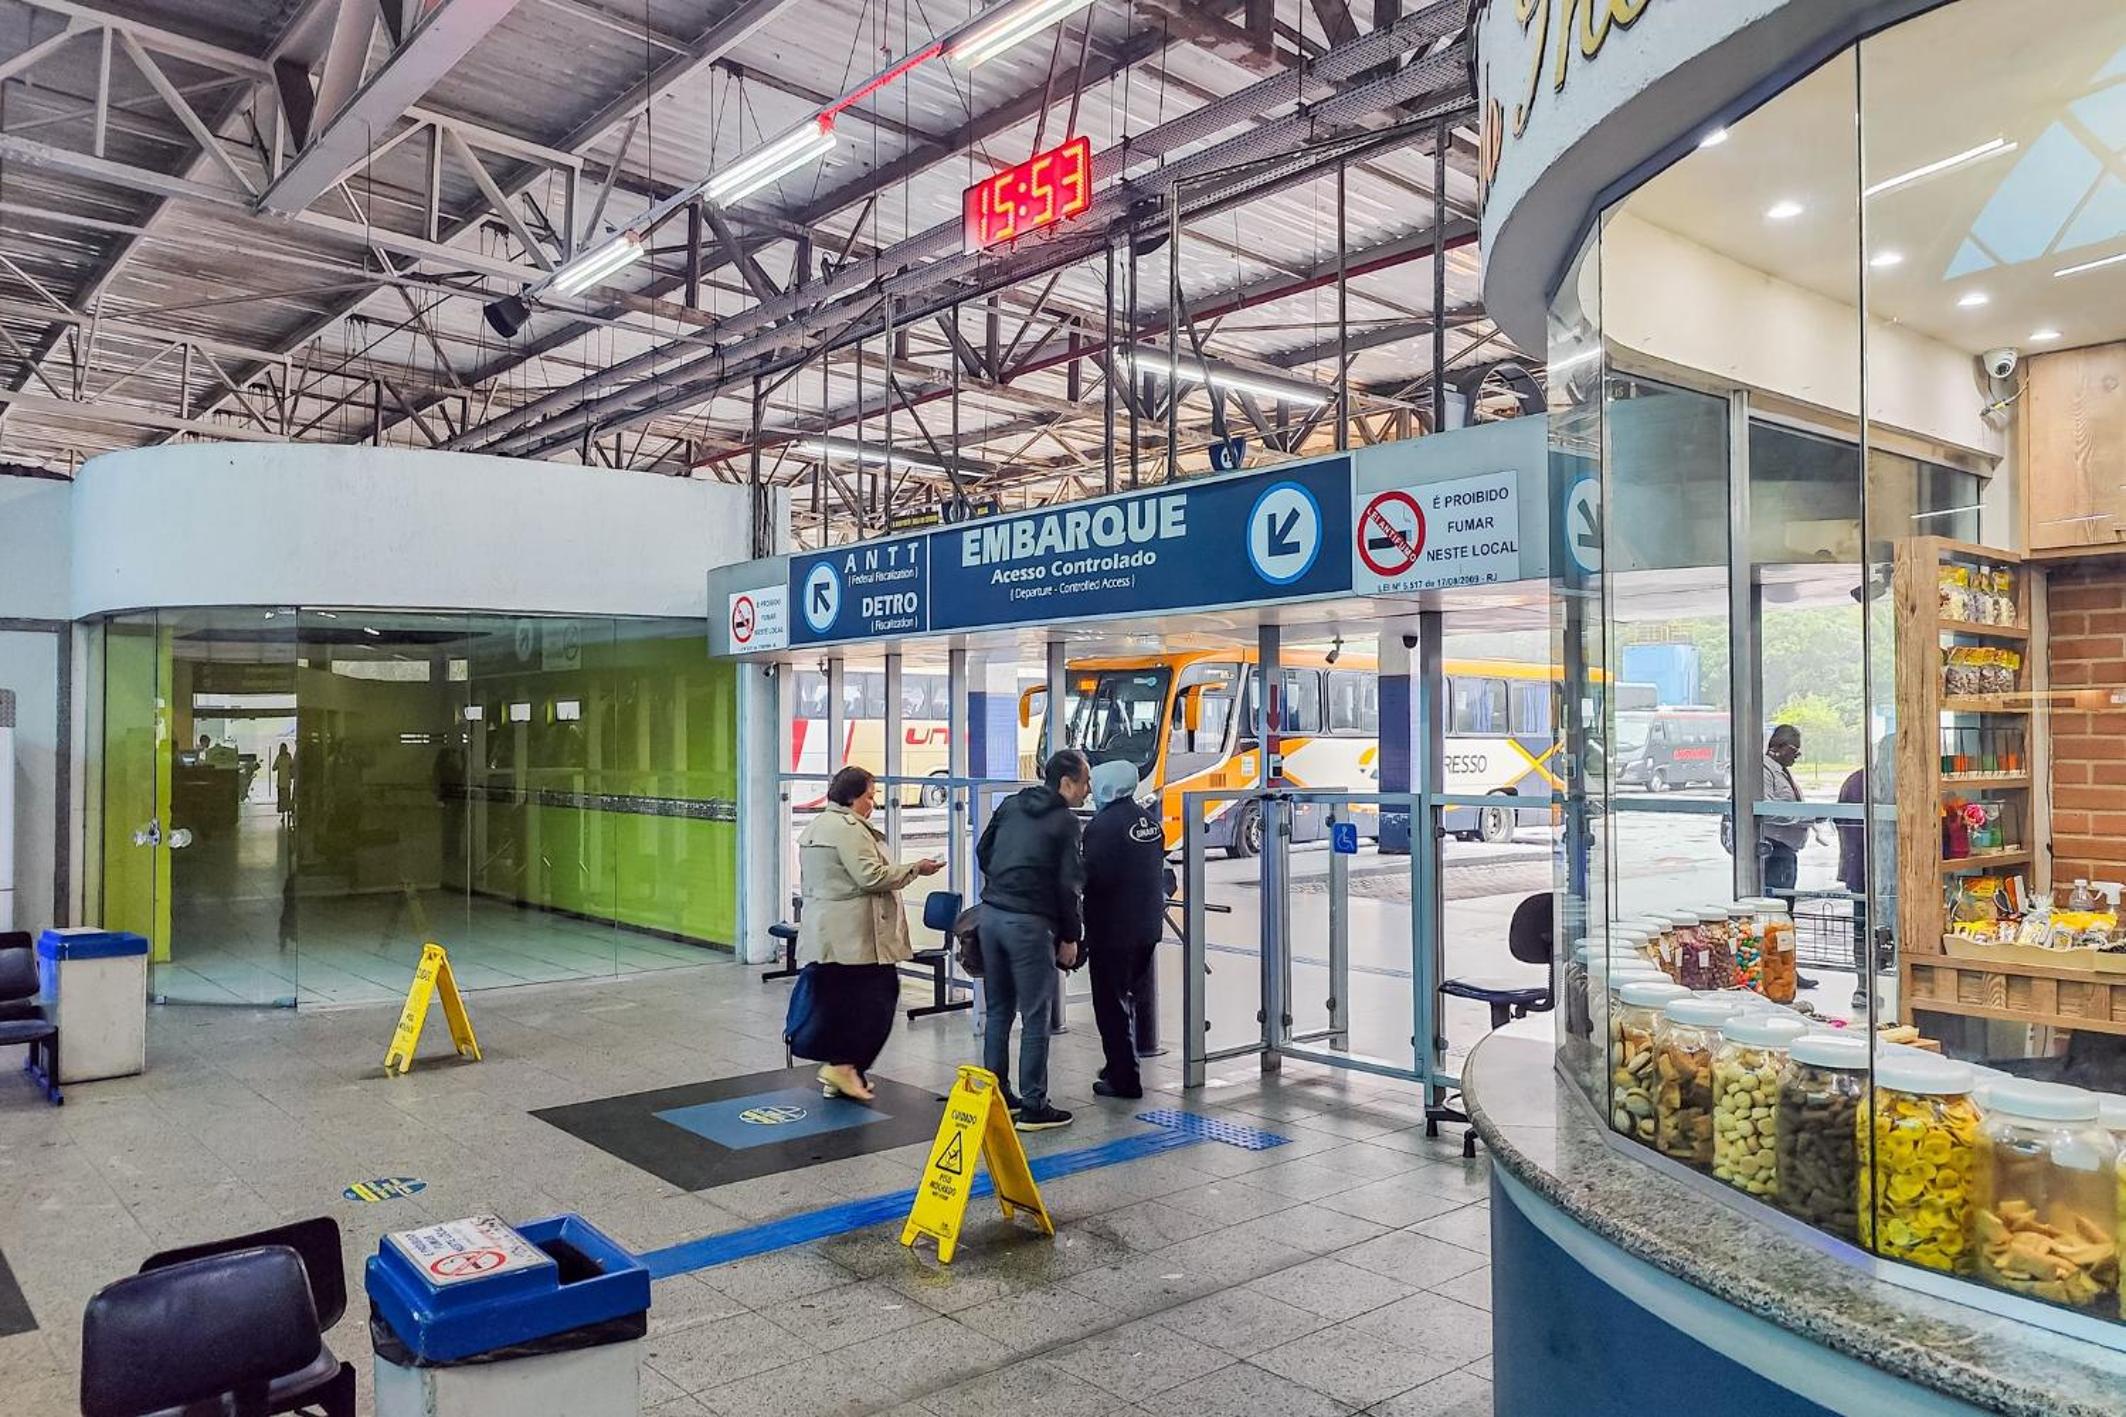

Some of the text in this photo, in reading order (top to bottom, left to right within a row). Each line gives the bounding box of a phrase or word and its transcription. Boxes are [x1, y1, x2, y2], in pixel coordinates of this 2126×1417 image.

[980, 143, 1084, 243] 15:53
[1433, 486, 1509, 510] É PROIBIDO
[1367, 506, 1380, 522] LEI
[1447, 516, 1495, 534] FUMAR
[961, 493, 1188, 568] EMBARQUE
[1426, 540, 1519, 562] NESTE LOCAL
[990, 550, 1157, 585] Acesso Controlado
[1486, 572, 1498, 582] RJ
[862, 591, 918, 618] DETRO
